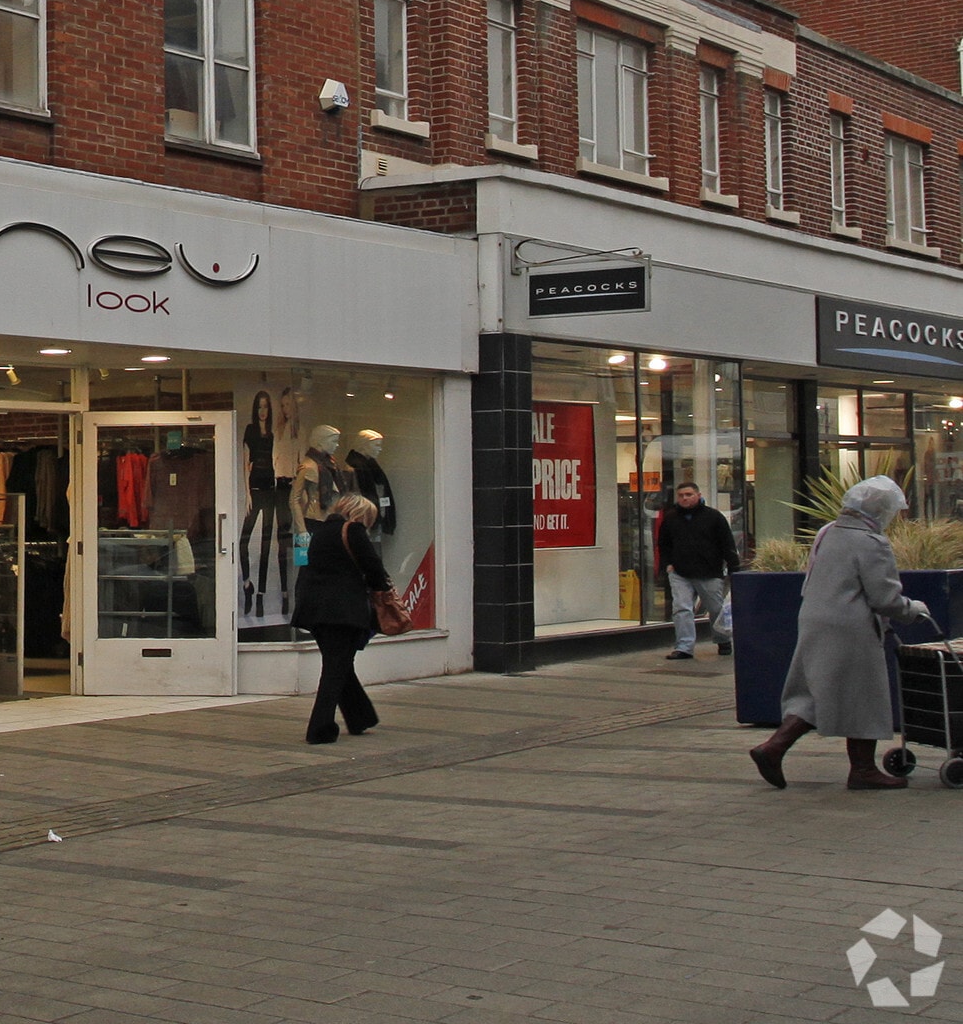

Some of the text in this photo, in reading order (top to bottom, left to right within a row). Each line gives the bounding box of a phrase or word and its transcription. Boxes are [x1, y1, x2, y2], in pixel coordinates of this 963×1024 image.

[87, 283, 170, 315] look
[536, 281, 637, 295] PEACOCKS
[835, 310, 963, 349] PEACOCKS
[533, 459, 581, 500] PRICE
[547, 514, 560, 530] GET
